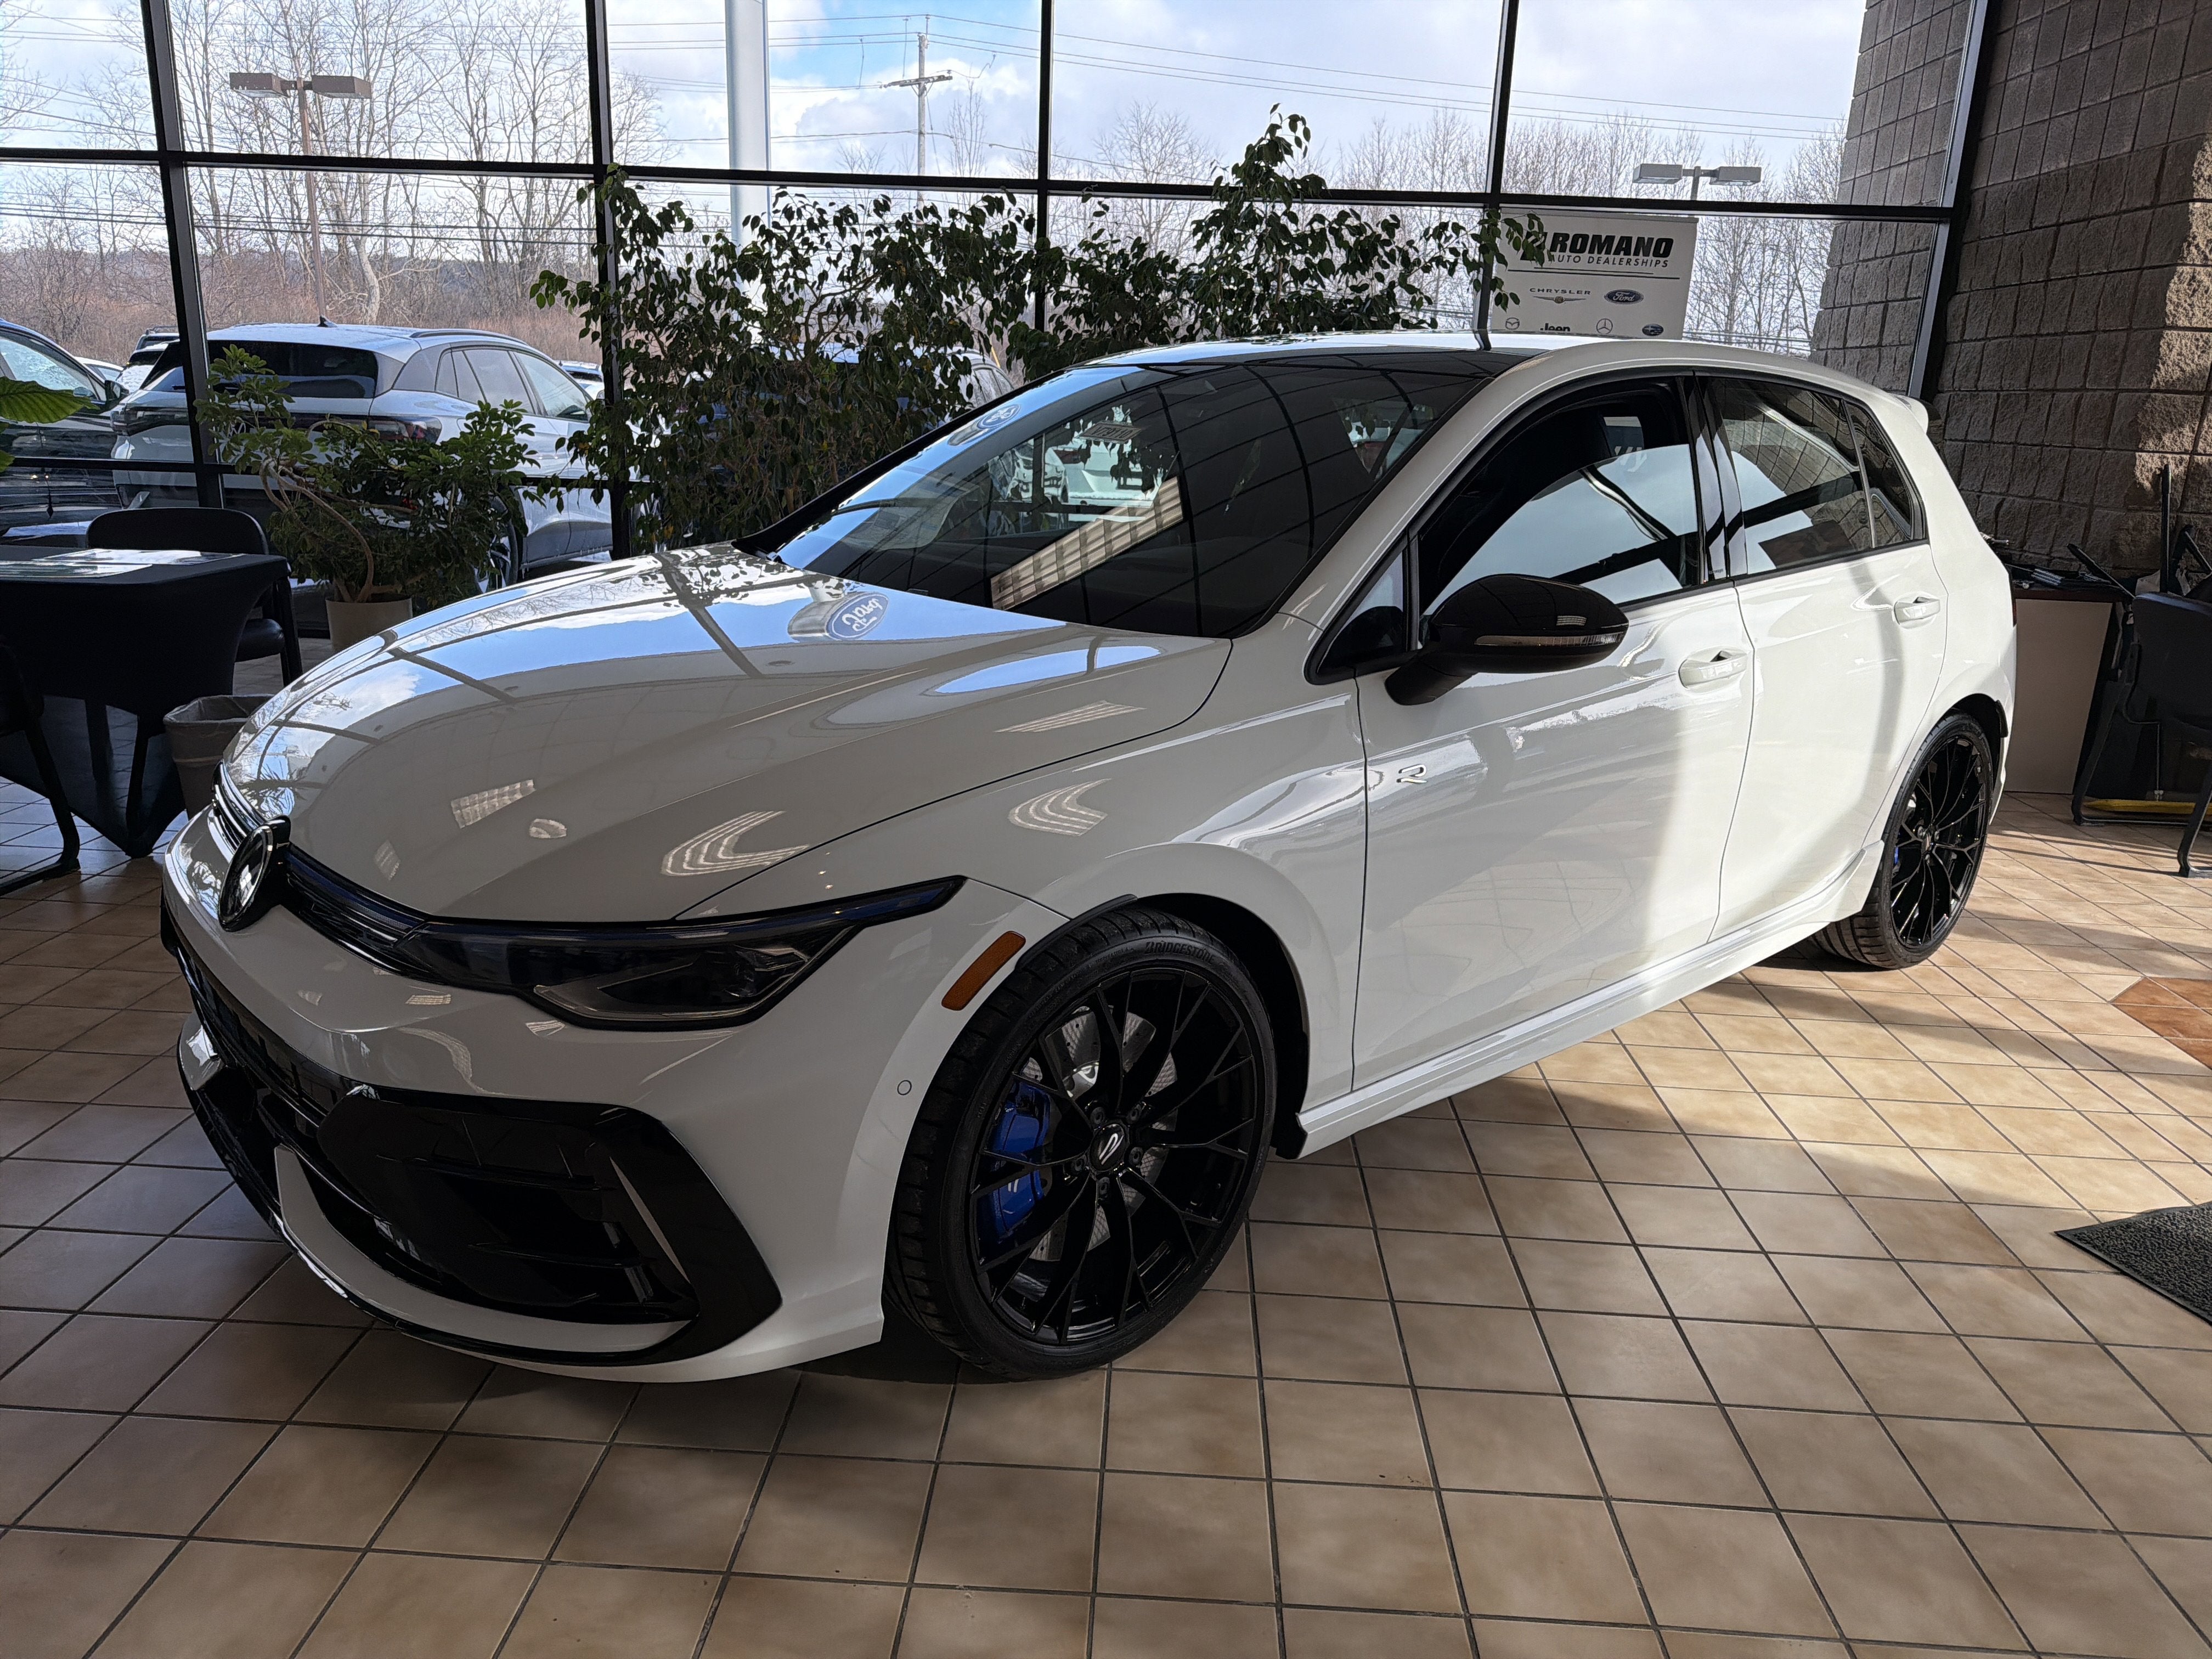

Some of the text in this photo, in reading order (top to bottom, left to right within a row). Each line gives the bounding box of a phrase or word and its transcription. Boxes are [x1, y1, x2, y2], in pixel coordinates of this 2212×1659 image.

[1549, 232, 1674, 258] ROMANO
[1587, 256, 1669, 268] DEALERSHIPS
[1613, 291, 1635, 301] Ford
[1144, 940, 1215, 963] BRIDGESTONE
